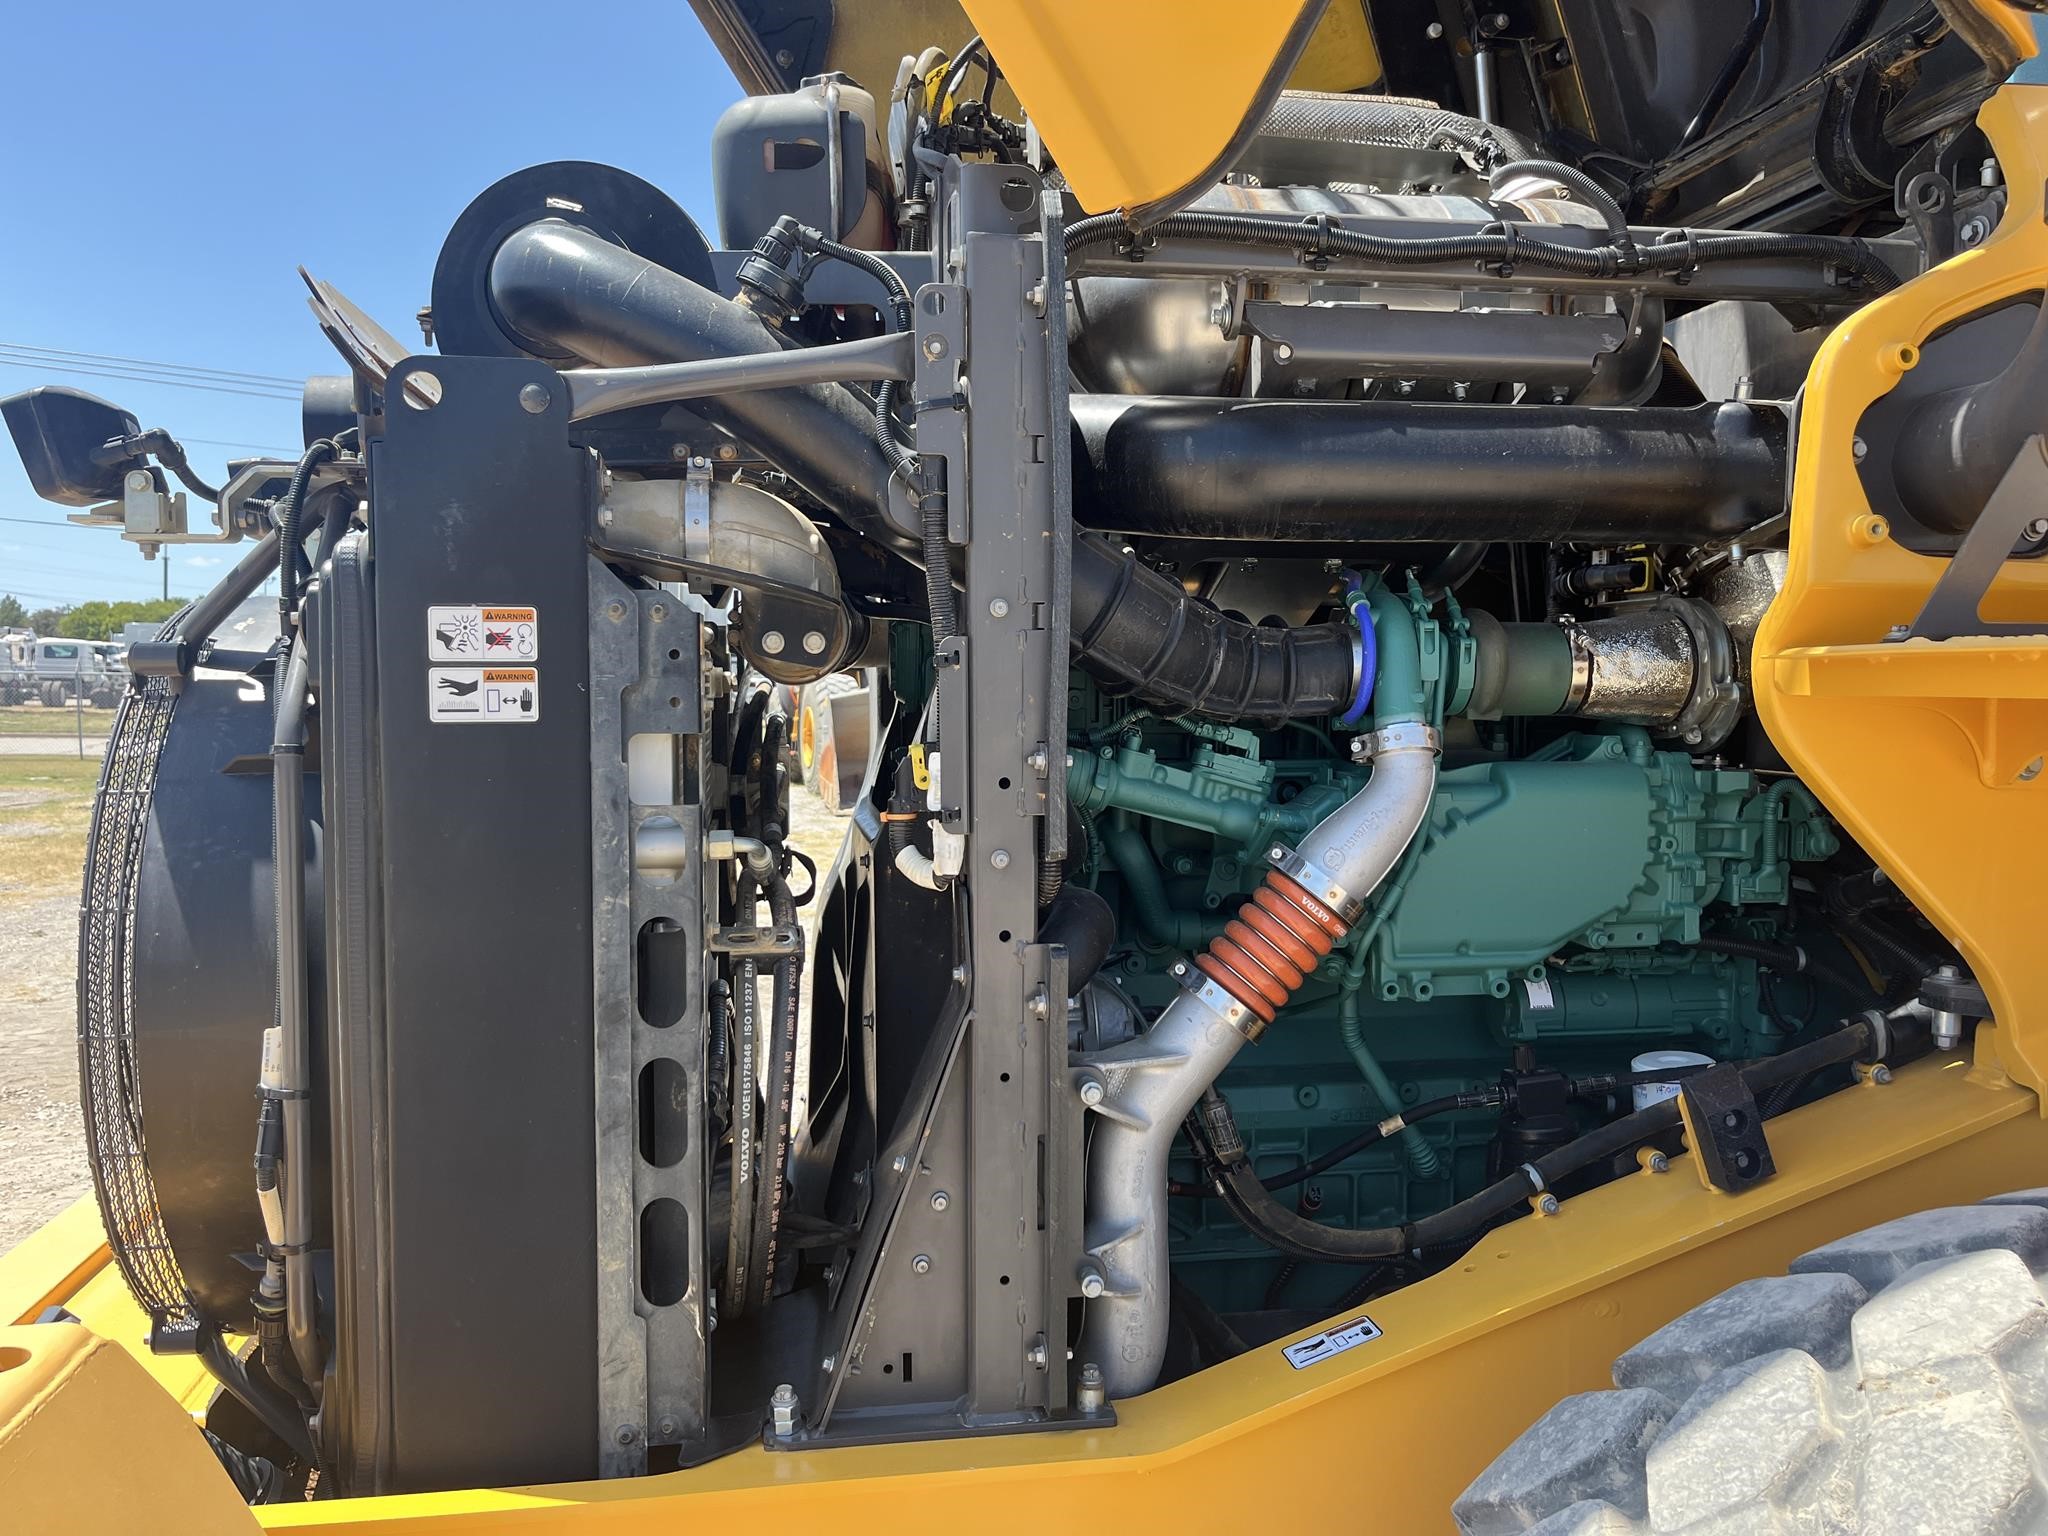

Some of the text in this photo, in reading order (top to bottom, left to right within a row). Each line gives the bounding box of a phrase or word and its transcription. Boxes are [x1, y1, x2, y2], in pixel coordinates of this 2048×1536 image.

[1301, 895, 1330, 923] VOLVO
[745, 963, 753, 978] EN
[745, 983, 753, 1013] 11237
[787, 996, 795, 1012] SAE
[744, 1015, 753, 1036] ISO
[785, 1014, 794, 1040] 100R17
[784, 1051, 792, 1062] DN
[783, 1065, 791, 1073] 16
[742, 1043, 752, 1119] VOE15175846
[782, 1080, 790, 1092] -10
[778, 1123, 787, 1136] WP
[740, 1127, 751, 1184] VOLVO
[776, 1142, 785, 1155] 210
[775, 1156, 783, 1168] bar
